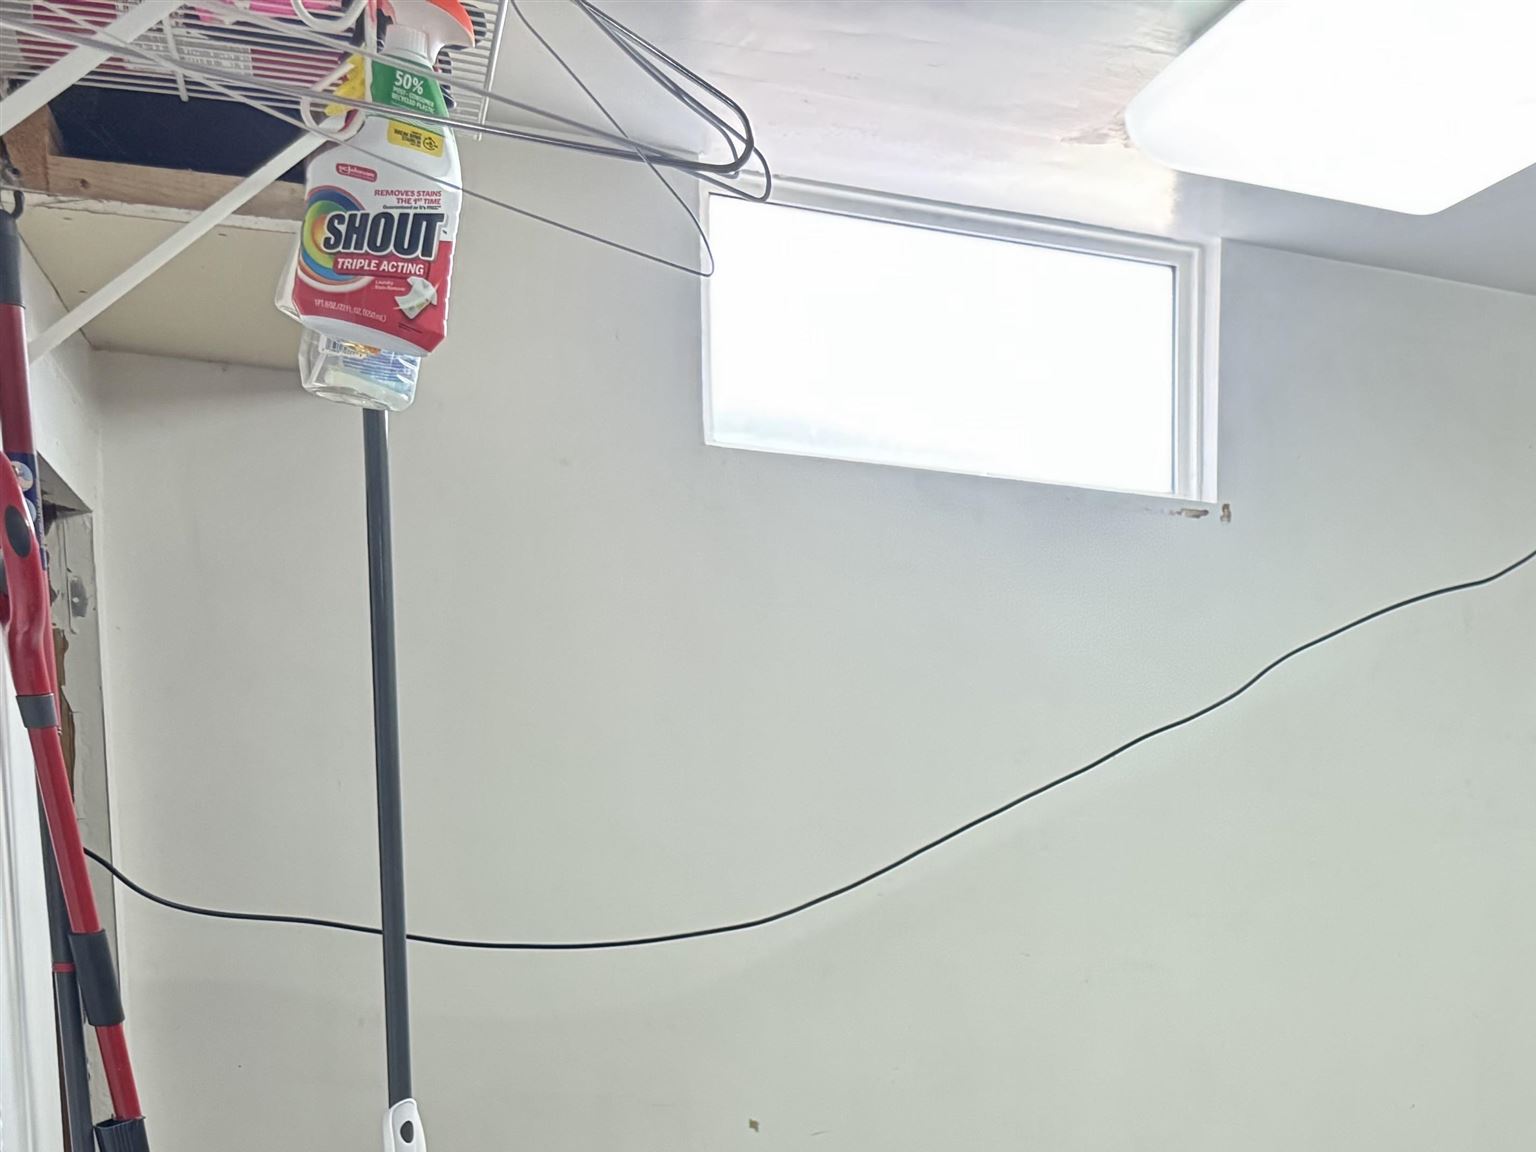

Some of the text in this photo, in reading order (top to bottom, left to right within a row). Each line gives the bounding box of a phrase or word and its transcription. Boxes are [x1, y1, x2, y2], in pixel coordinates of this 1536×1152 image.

[394, 70, 424, 95] 50%
[374, 189, 442, 198] REMOVES STAINS
[323, 211, 445, 260] SHOUT
[337, 259, 424, 275] TRIPLE ACTING
